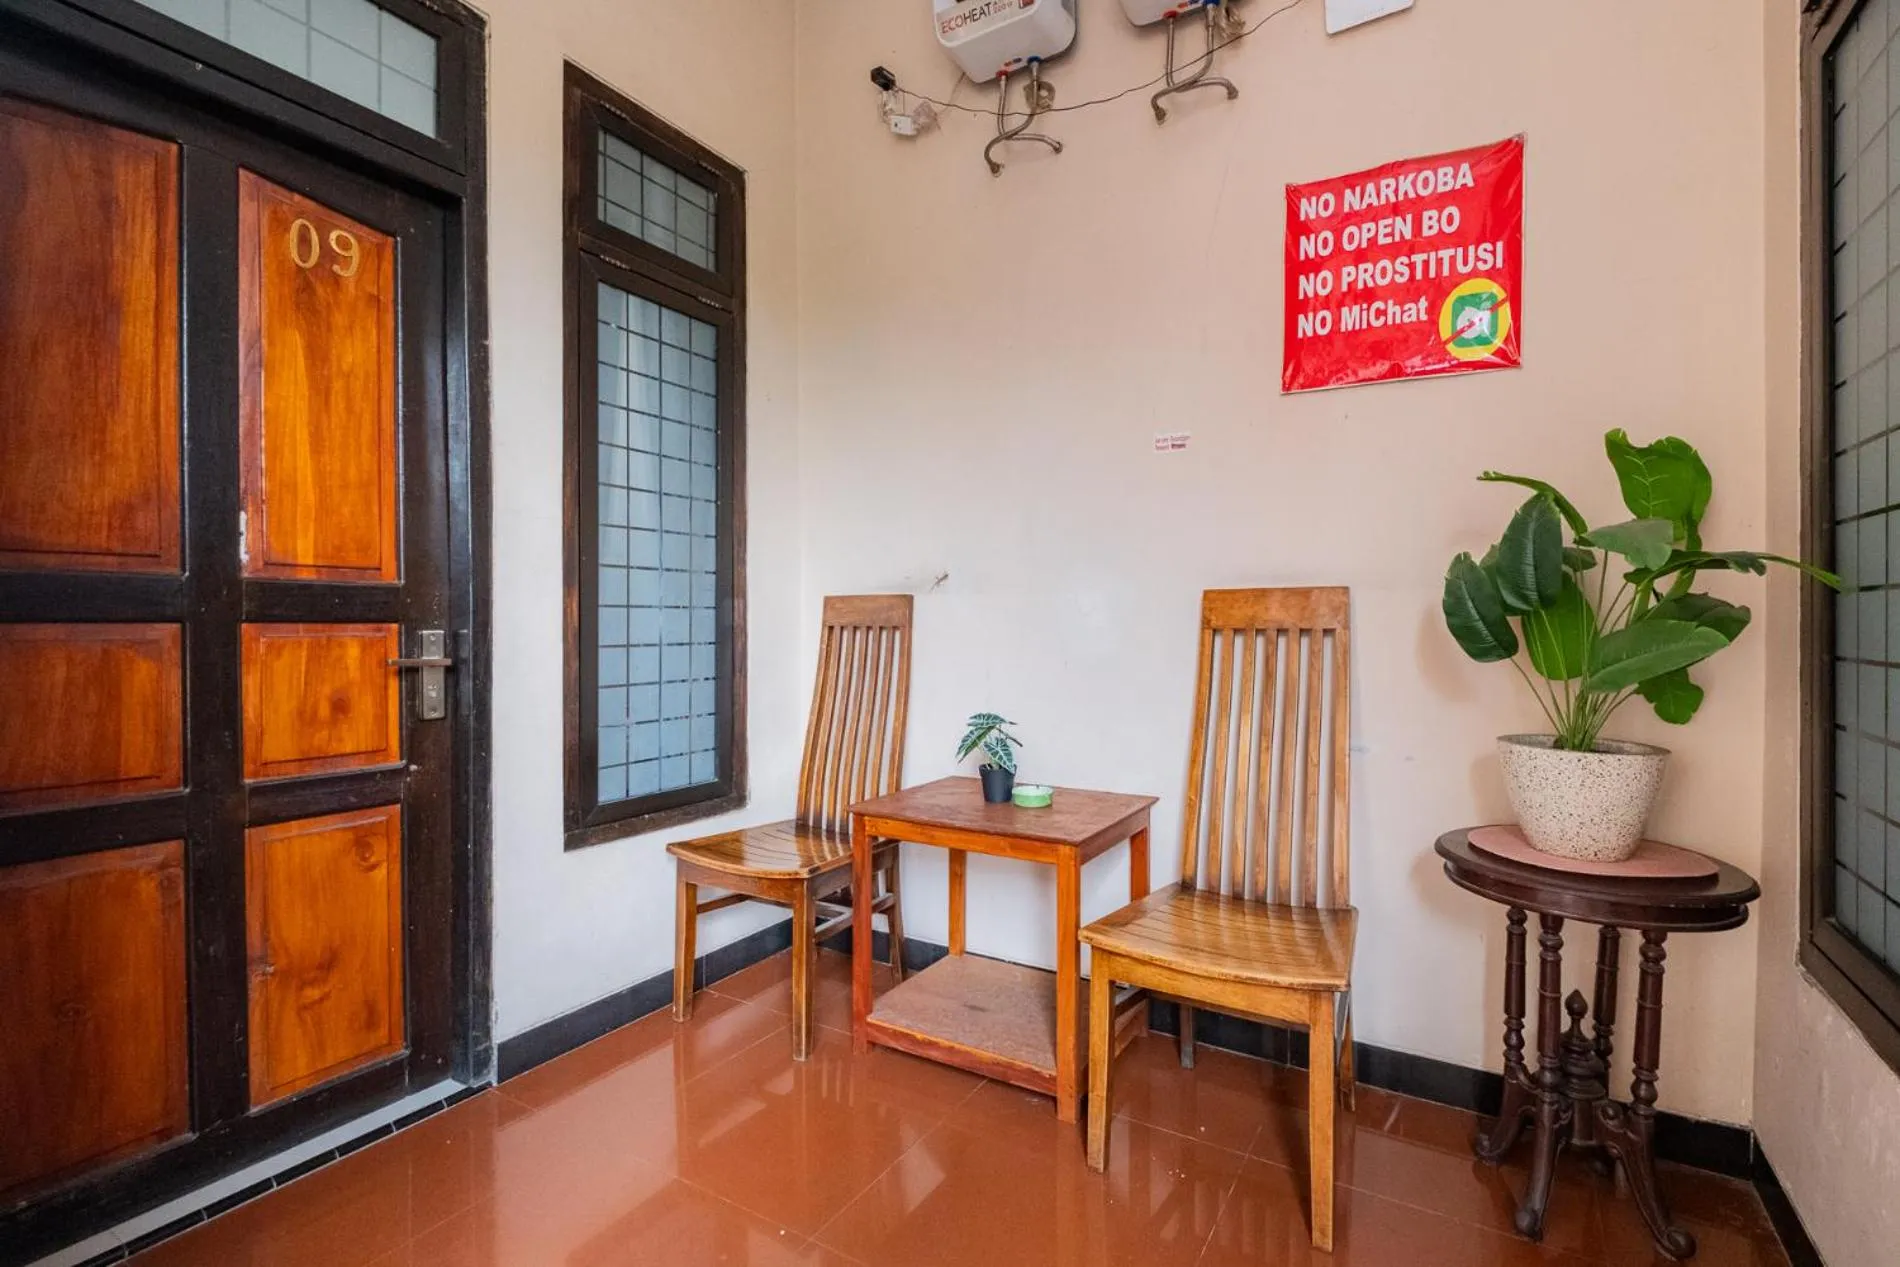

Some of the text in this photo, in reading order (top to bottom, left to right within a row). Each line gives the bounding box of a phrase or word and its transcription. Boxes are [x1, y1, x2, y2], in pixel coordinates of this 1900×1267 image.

[942, 2, 994, 33] ECOHEAT
[1300, 163, 1474, 221] NO NARKOBA
[290, 219, 359, 276] 09
[1300, 206, 1460, 260] NO OPEN BO
[1299, 241, 1503, 299] NO PROSTITUSI
[1297, 296, 1428, 338] NO MiChat
